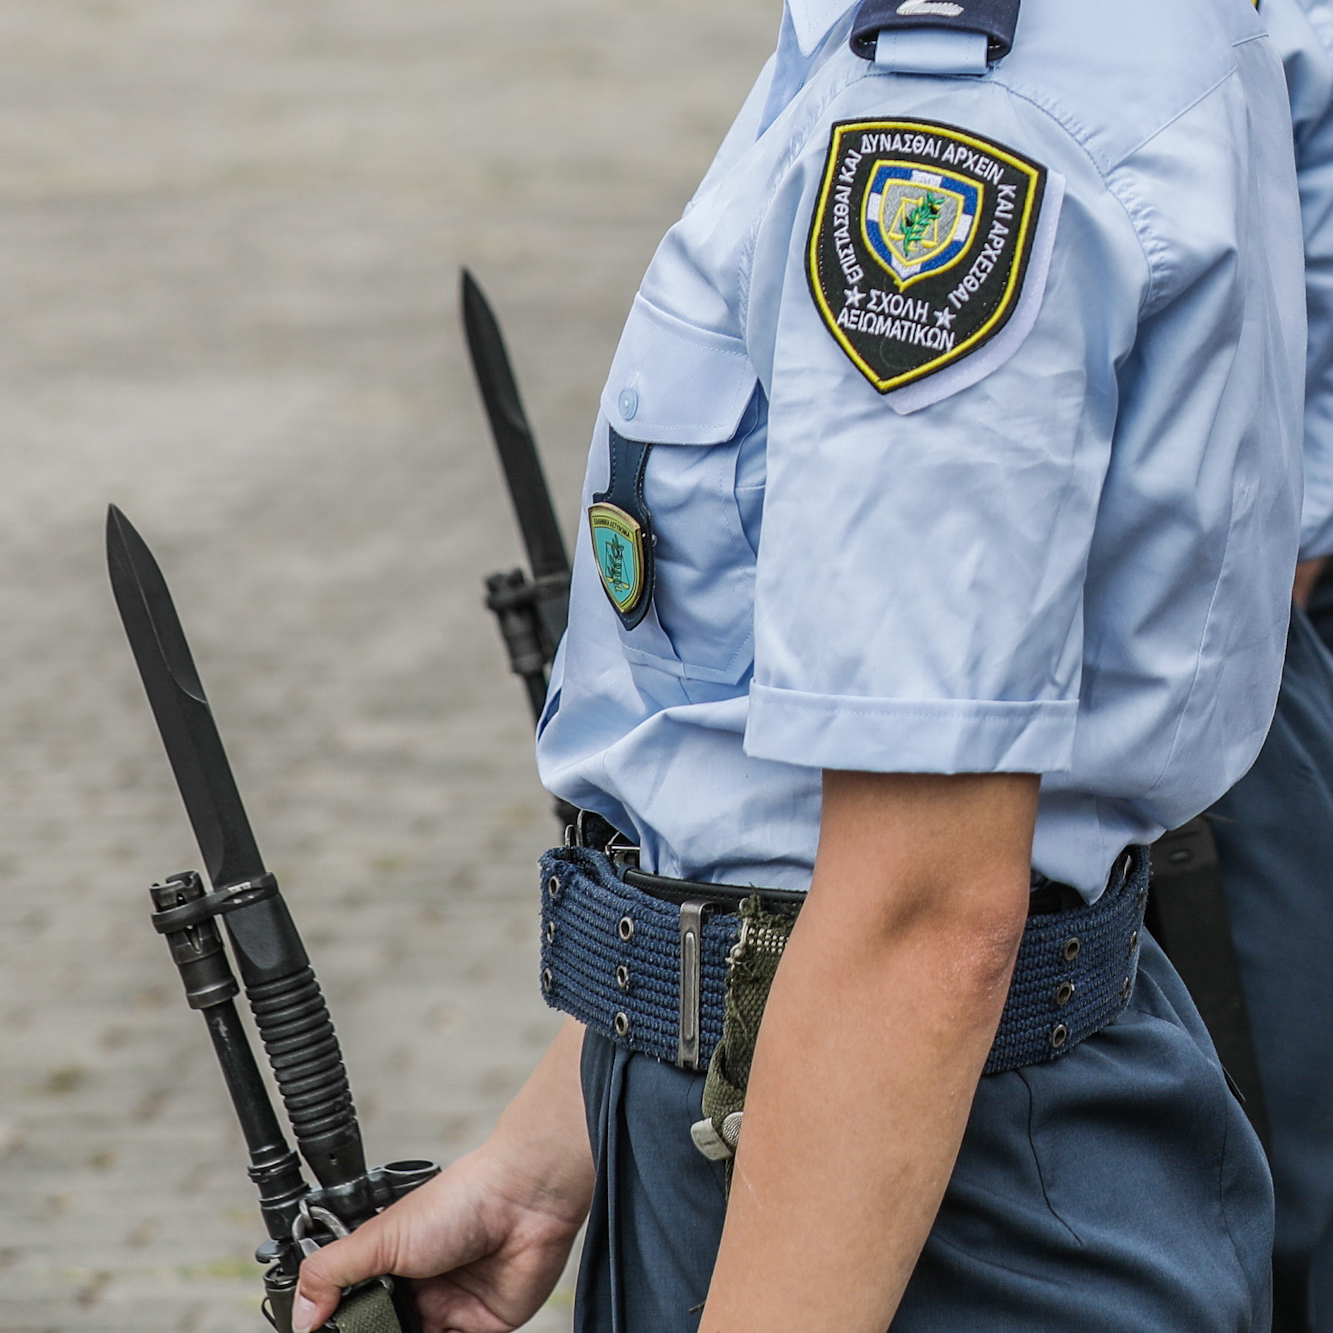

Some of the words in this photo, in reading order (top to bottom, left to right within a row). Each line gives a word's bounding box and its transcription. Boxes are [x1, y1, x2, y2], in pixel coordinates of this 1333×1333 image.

[860, 133, 942, 158] ΔΥΝΑΣΘΑΙ
[838, 149, 862, 183] ΚΑΙ
[941, 143, 1004, 185] ΑΡΧΕΙΝ
[994, 184, 1016, 220] ΚΑΙ
[833, 185, 864, 285] ΕΠΙΣΤΑΣΘΑΙ
[947, 220, 1009, 309] ΑΡΧΕΣΘΑΙ
[866, 288, 929, 323] ΣΧΟΛΗ
